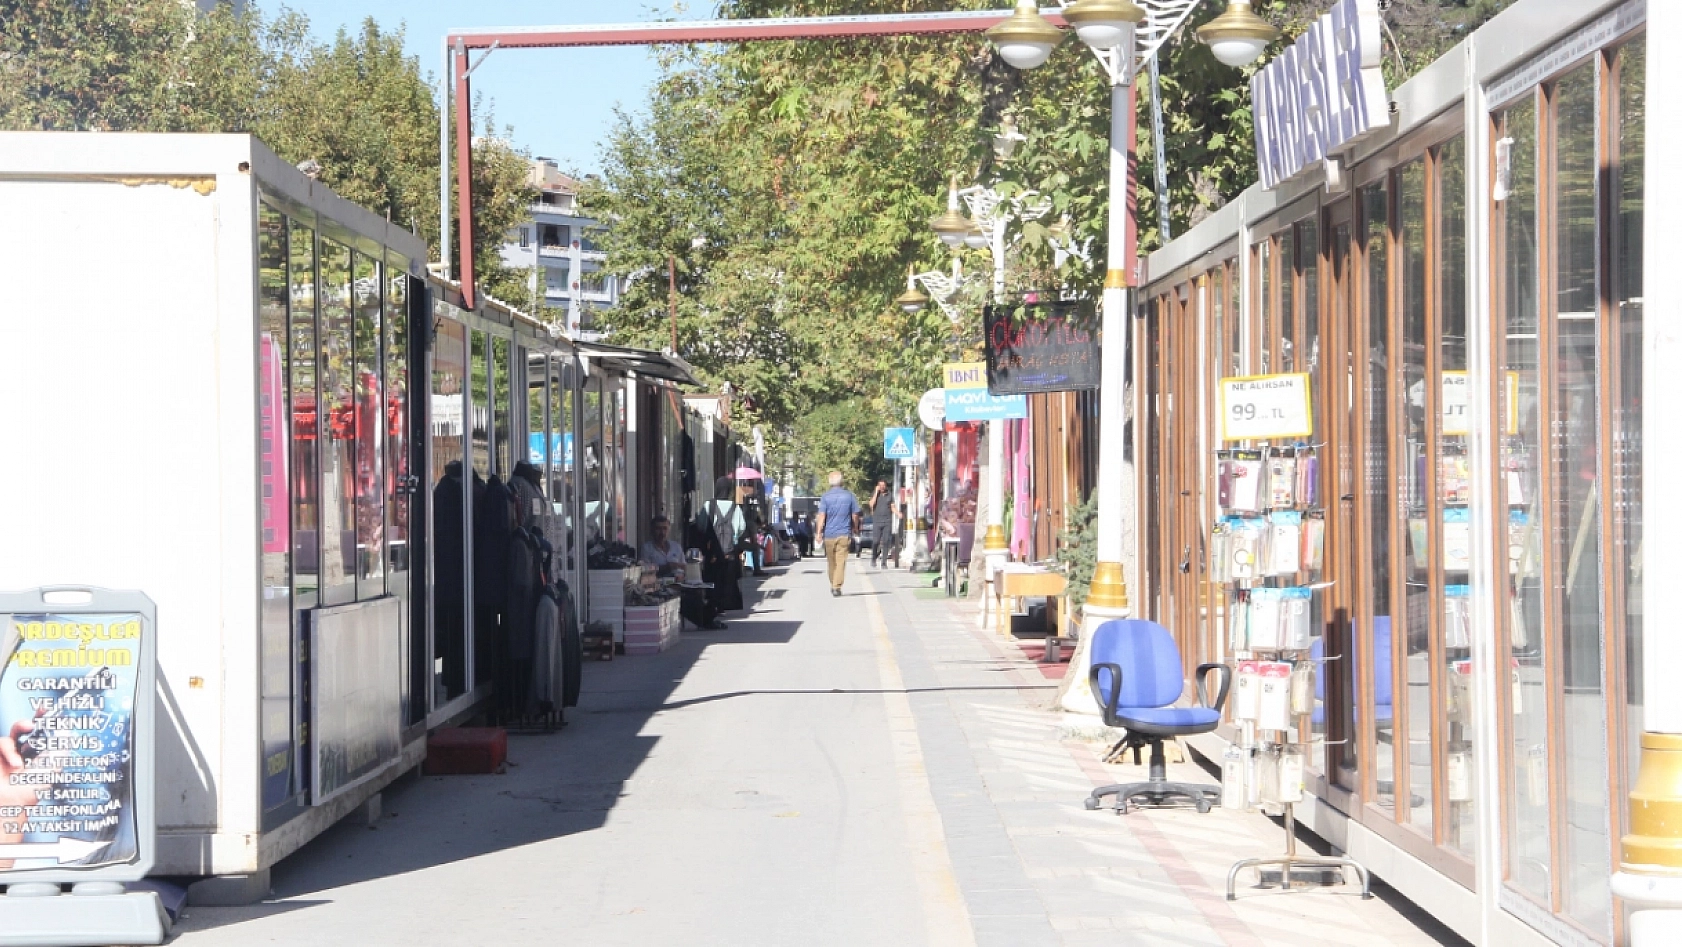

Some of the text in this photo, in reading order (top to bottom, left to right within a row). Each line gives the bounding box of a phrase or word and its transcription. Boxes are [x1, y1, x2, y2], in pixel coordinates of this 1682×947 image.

[948, 366, 979, 383] İBNİ
[1271, 408, 1285, 418] TL
[11, 645, 132, 667] REMİUM
[17, 674, 117, 690] GARANTİLİ
[29, 696, 105, 711] VE HIZLI
[35, 714, 100, 730] TEKNİK
[36, 734, 98, 750] SERVİS
[55, 756, 109, 767] TELEFON
[35, 788, 98, 800] VE SATILIR
[0, 806, 22, 817] CEP
[21, 822, 36, 832] AY
[40, 820, 82, 832] TAKSİT
